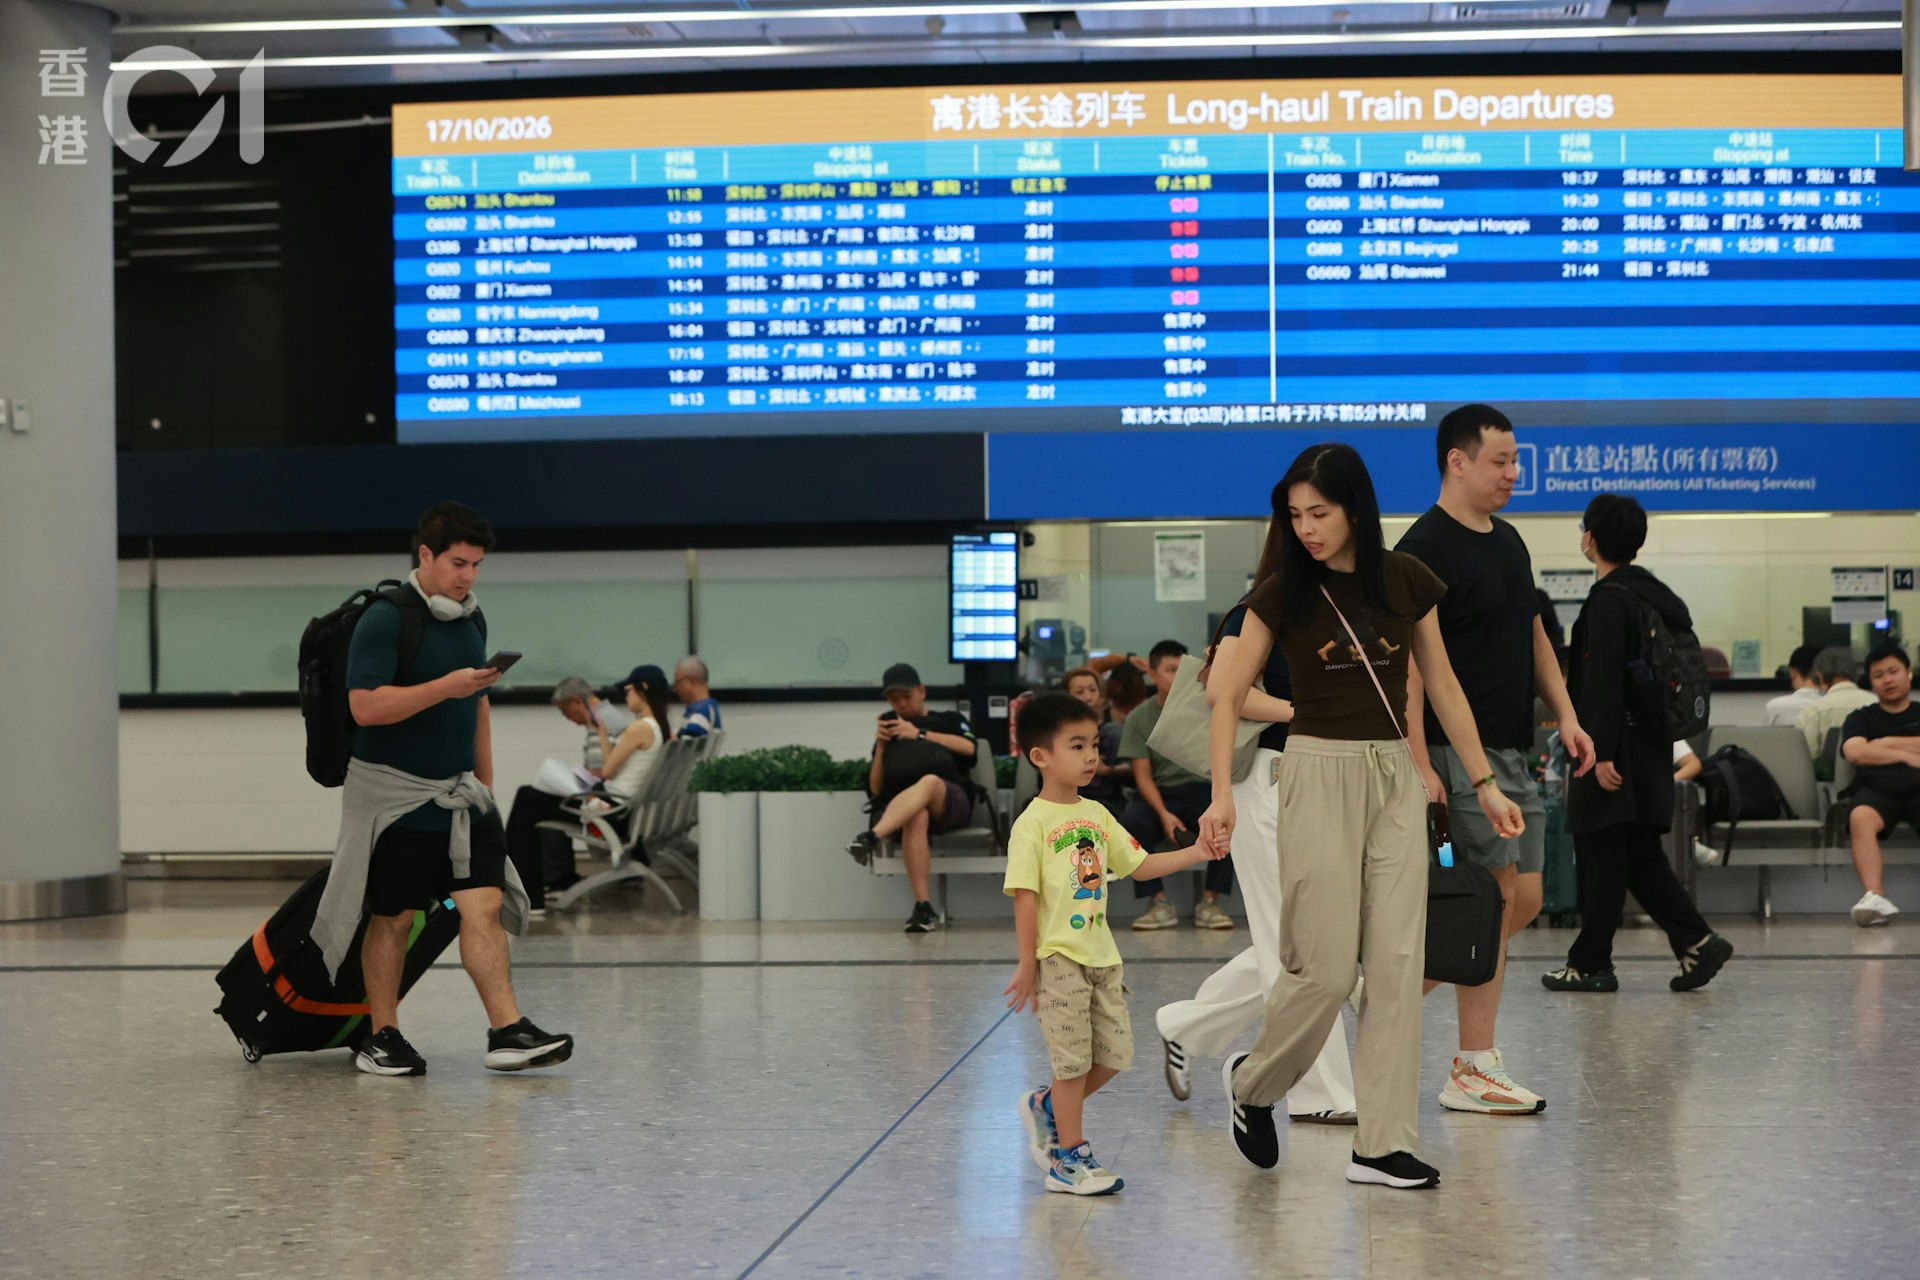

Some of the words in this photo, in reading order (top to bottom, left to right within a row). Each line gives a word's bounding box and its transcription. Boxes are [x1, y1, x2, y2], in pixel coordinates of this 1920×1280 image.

[929, 92, 1146, 131] 离港长途列车
[1167, 92, 1330, 130] Long-haul
[1338, 91, 1422, 121] Train
[1433, 88, 1615, 126] Departures
[426, 116, 552, 142] 17/10/2026
[1545, 444, 1778, 473] 直達站點(所有票務)
[1545, 477, 1588, 491] Direct
[1591, 476, 1680, 491] Destinations
[1683, 477, 1703, 491] (All
[1706, 477, 1760, 492] Ticketing
[1763, 477, 1816, 490] Services)
[1021, 582, 1036, 596] 11
[1895, 572, 1912, 587] 14
